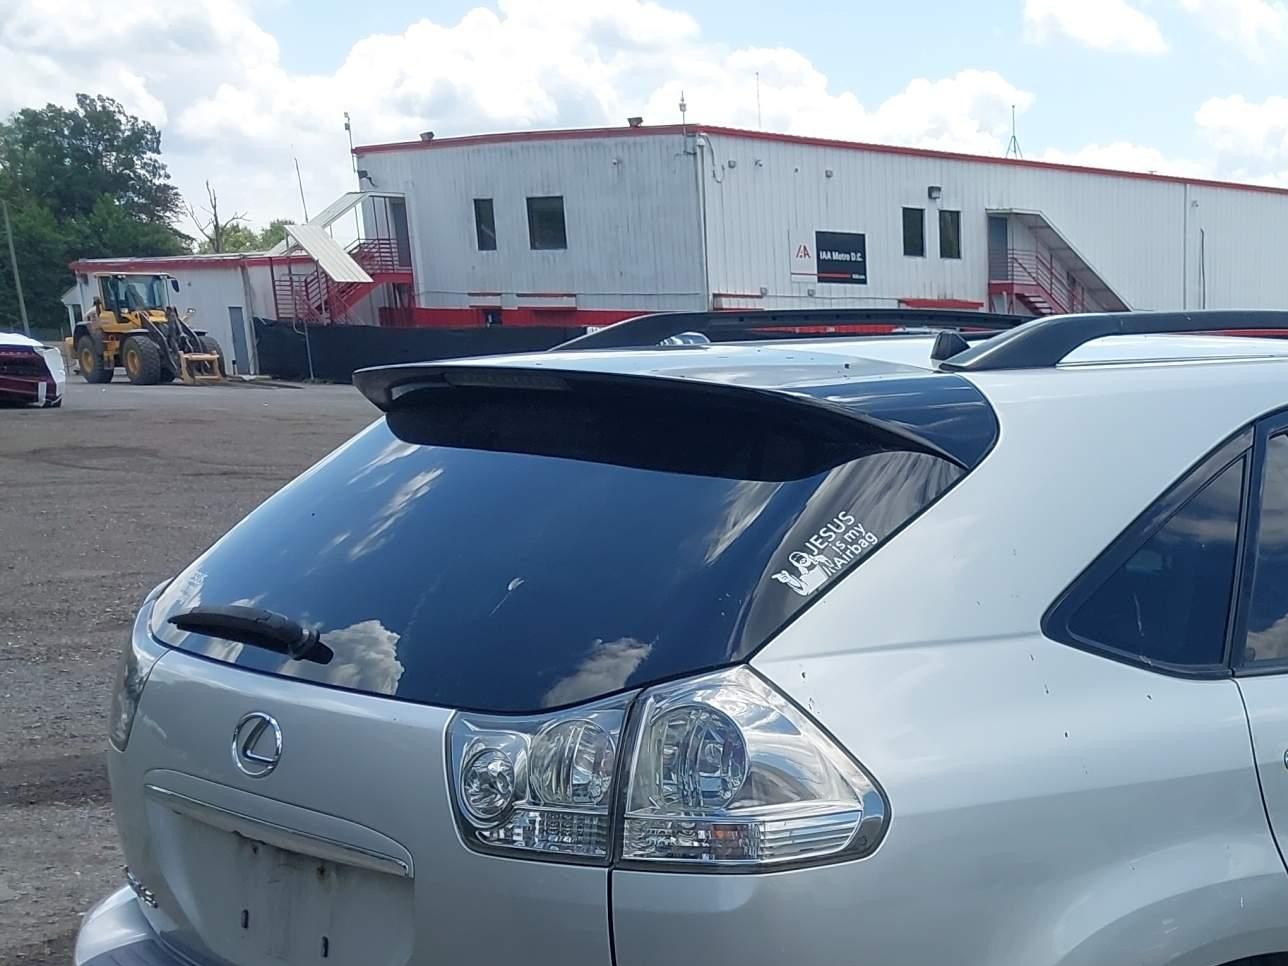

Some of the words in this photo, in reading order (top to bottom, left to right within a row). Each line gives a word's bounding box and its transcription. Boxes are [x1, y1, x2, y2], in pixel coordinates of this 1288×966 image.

[819, 250, 832, 260] IAA
[832, 251, 851, 261] Metro
[805, 511, 855, 555] JESUS
[828, 540, 846, 555] is
[843, 523, 866, 542] my
[832, 532, 878, 570] Airbag
